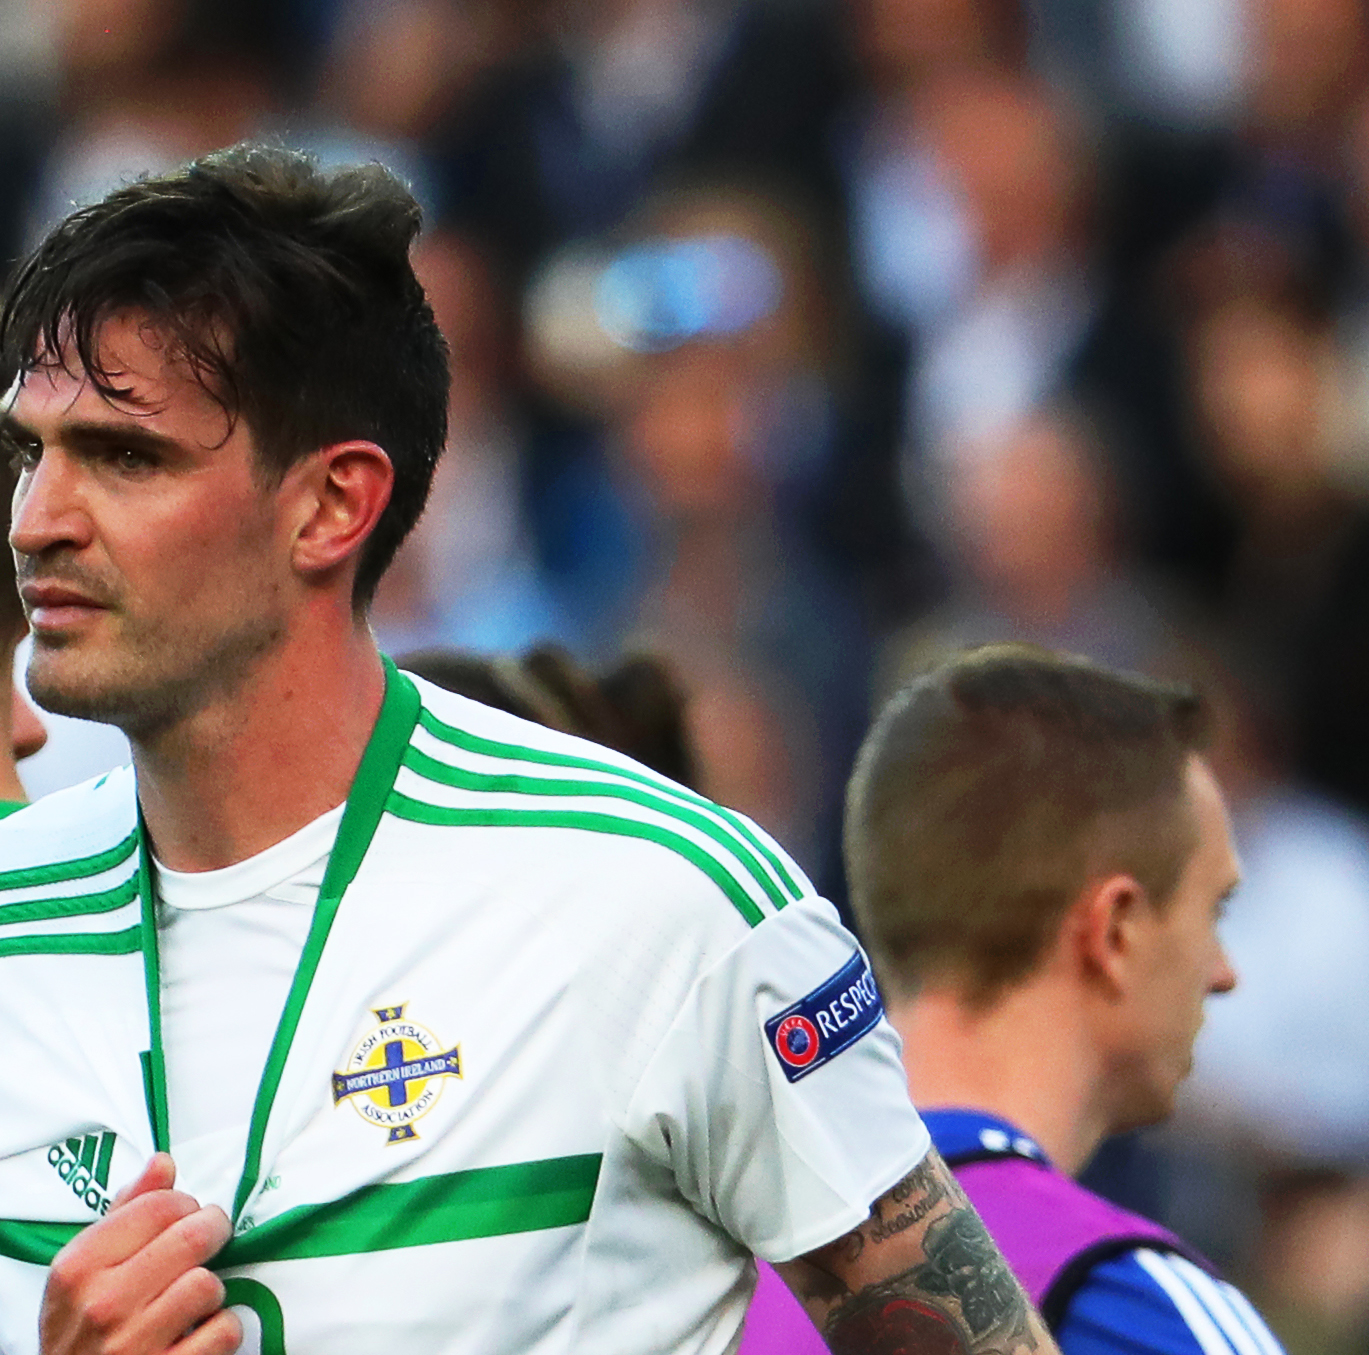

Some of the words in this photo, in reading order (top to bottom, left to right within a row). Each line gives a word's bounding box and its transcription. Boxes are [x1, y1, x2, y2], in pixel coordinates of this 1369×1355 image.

[815, 969, 877, 1039] RESPEC
[352, 1034, 378, 1066] IRISH
[379, 1024, 432, 1051] FOOTBALL
[346, 1067, 400, 1091] NORTHERN
[400, 1058, 447, 1079] IRELAND
[362, 1089, 433, 1123] ASSOCIATION
[47, 1145, 111, 1216] adidas
